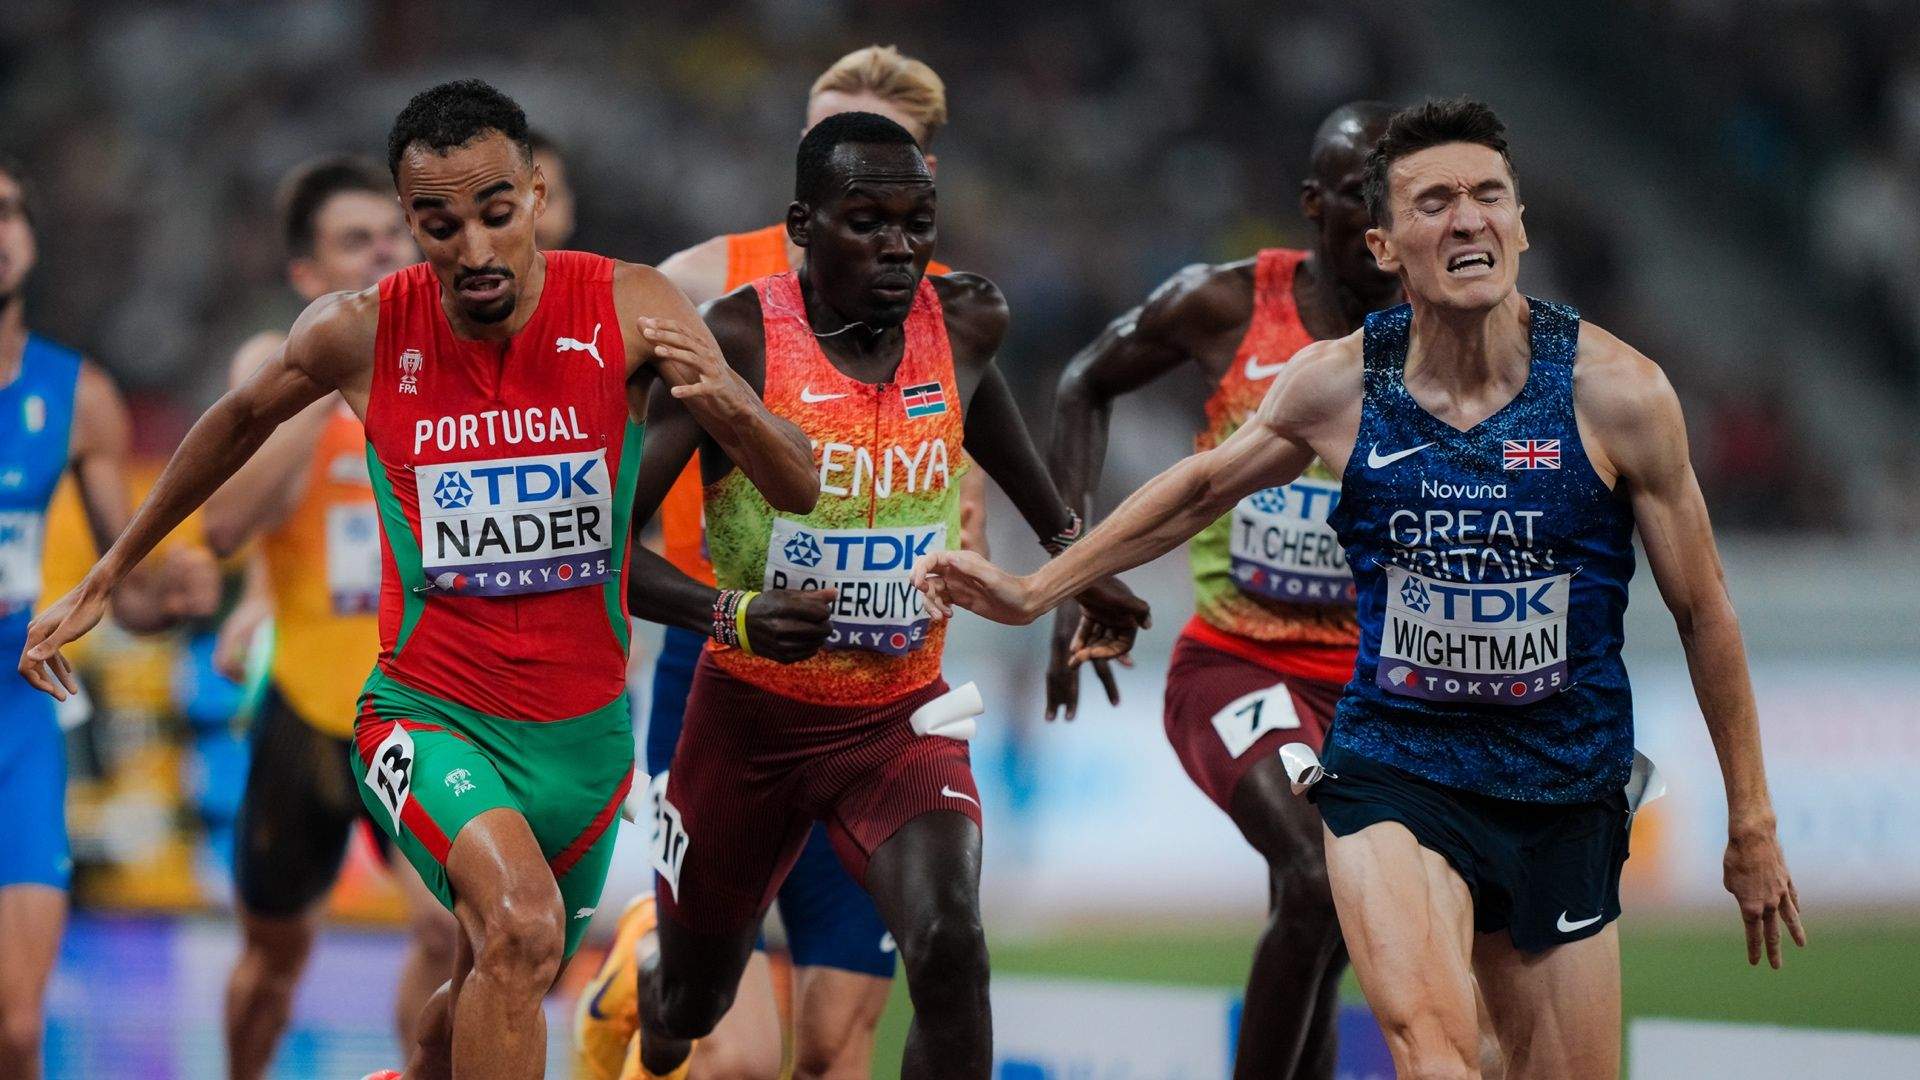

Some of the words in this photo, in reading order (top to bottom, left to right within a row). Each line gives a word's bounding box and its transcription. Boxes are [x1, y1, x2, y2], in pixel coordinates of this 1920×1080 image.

[399, 382, 418, 395] FPA
[414, 406, 588, 455] PORTUGAL
[470, 459, 599, 506] TDK
[812, 438, 949, 498] ENYA
[1421, 480, 1507, 498] Novuna
[436, 505, 602, 559] NADER
[1389, 510, 1544, 548] GREAT
[823, 532, 936, 572] TDK
[1429, 581, 1556, 623] TDK
[1393, 617, 1559, 671] WIGHTMAN
[1235, 699, 1265, 731] 7
[377, 744, 412, 813] 13
